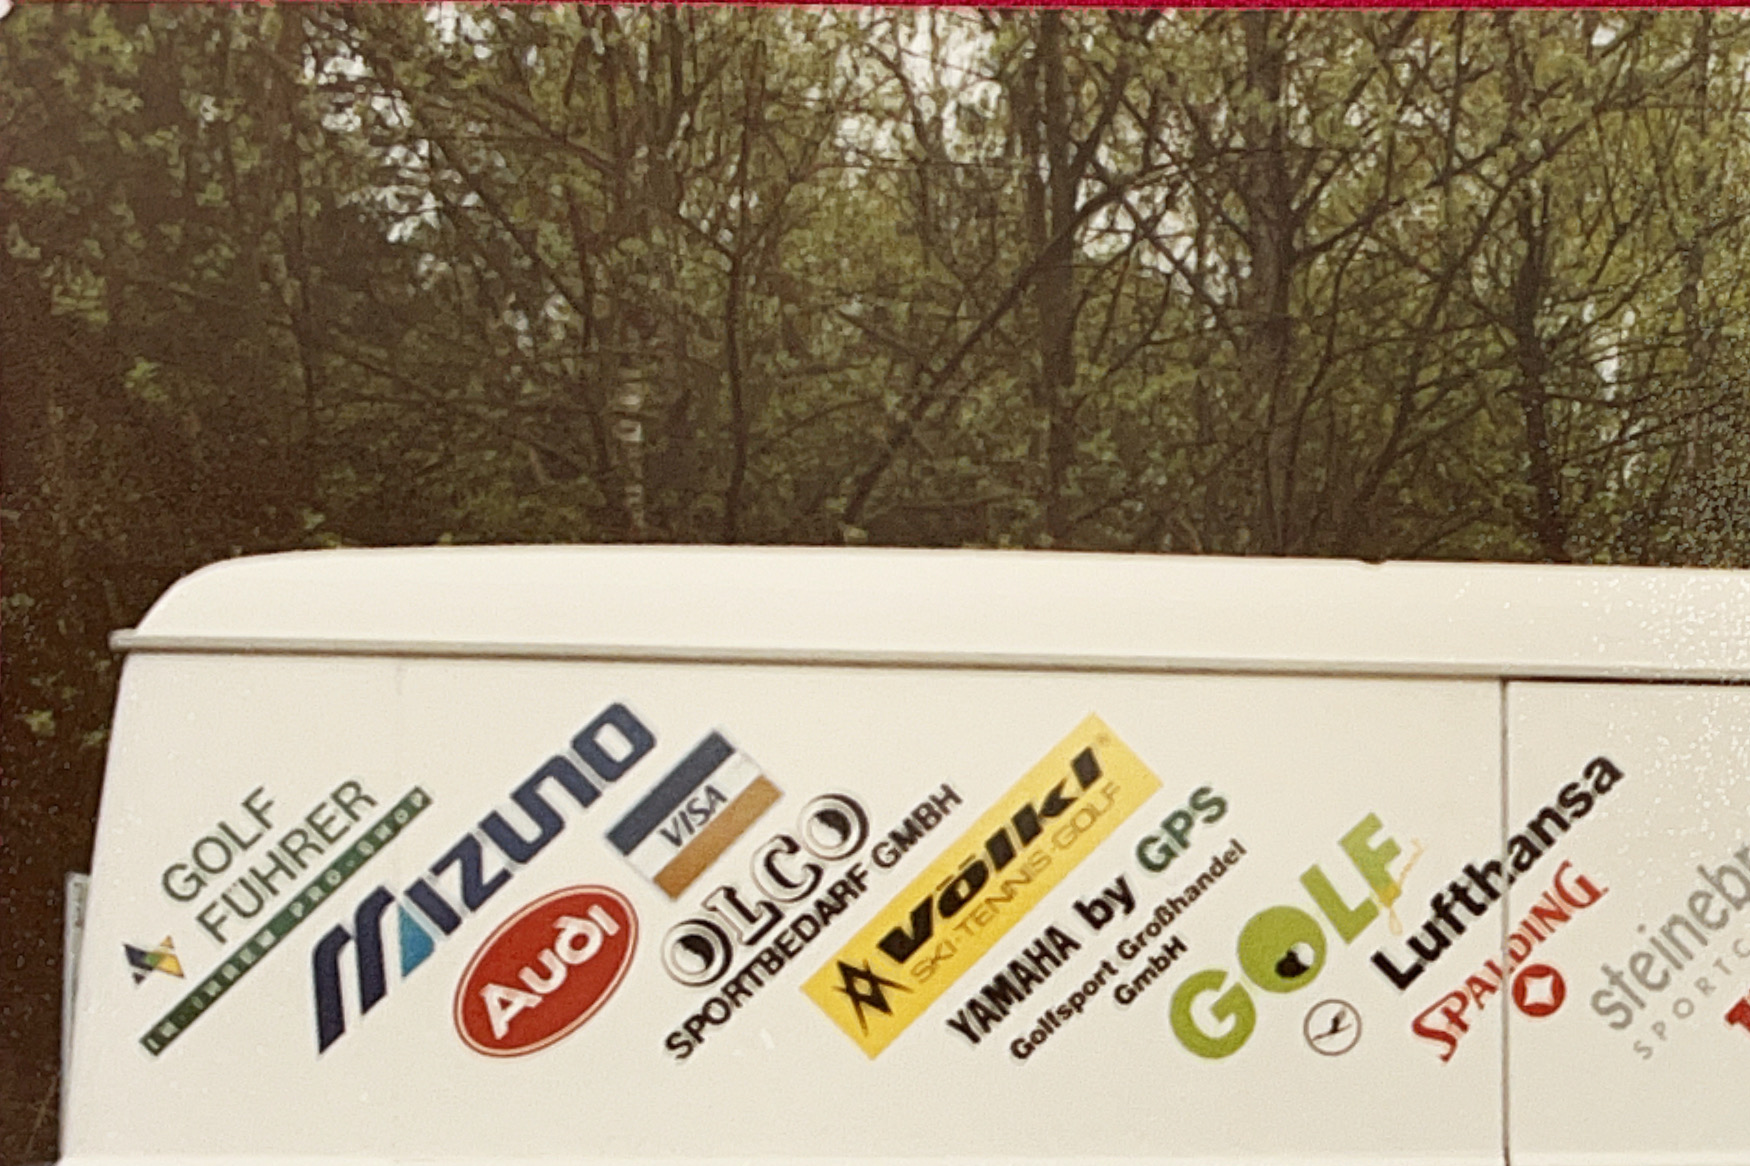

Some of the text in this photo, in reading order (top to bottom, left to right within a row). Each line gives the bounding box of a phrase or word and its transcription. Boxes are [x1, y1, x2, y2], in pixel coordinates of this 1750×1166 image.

[161, 787, 280, 901] GOLF
[197, 780, 378, 944] FÜHRER
[659, 785, 728, 847] VISA
[662, 793, 870, 986] OLCO
[946, 786, 1228, 1047] YAMAHA by GPS
[1371, 755, 1625, 991] Lufthansa
[664, 784, 964, 1060] SPORTBEDARF GMBH
[1010, 838, 1247, 1062] Golfsport Großhandel
[1113, 937, 1188, 1009] GmbH
[1170, 812, 1401, 1059] GOLF
[1411, 858, 1609, 1062] SPALDING
